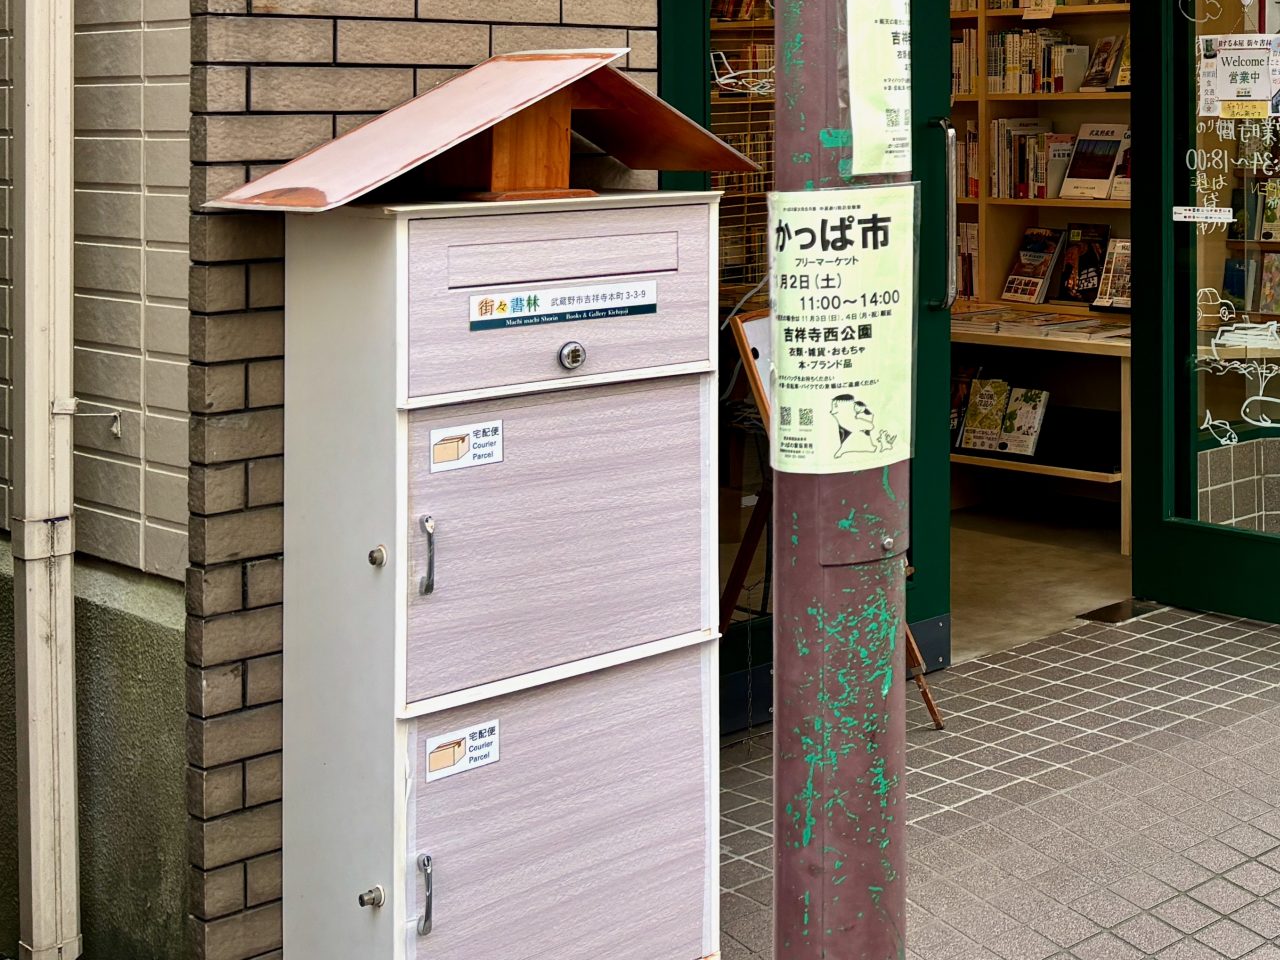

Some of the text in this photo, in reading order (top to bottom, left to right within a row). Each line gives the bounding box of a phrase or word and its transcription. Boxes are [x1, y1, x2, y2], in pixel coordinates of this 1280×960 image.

[1221, 55, 1265, 67] Welcome
[1228, 71, 1260, 84] 営業中
[775, 213, 892, 253] かっぱ市
[794, 256, 859, 268] フリーマーケット
[478, 289, 646, 317] 街々書林 武蔵野市吉祥寺本町 3-3-9
[565, 312, 582, 320] Books
[588, 309, 607, 319] Gallery
[784, 323, 873, 343] 吉祥寺西公園
[473, 426, 500, 439] 宅配便
[472, 441, 497, 450] Courier
[472, 451, 494, 461] Parcel
[469, 725, 496, 742] 宅配便
[468, 741, 494, 753] Courier
[468, 751, 490, 764] Parcel
